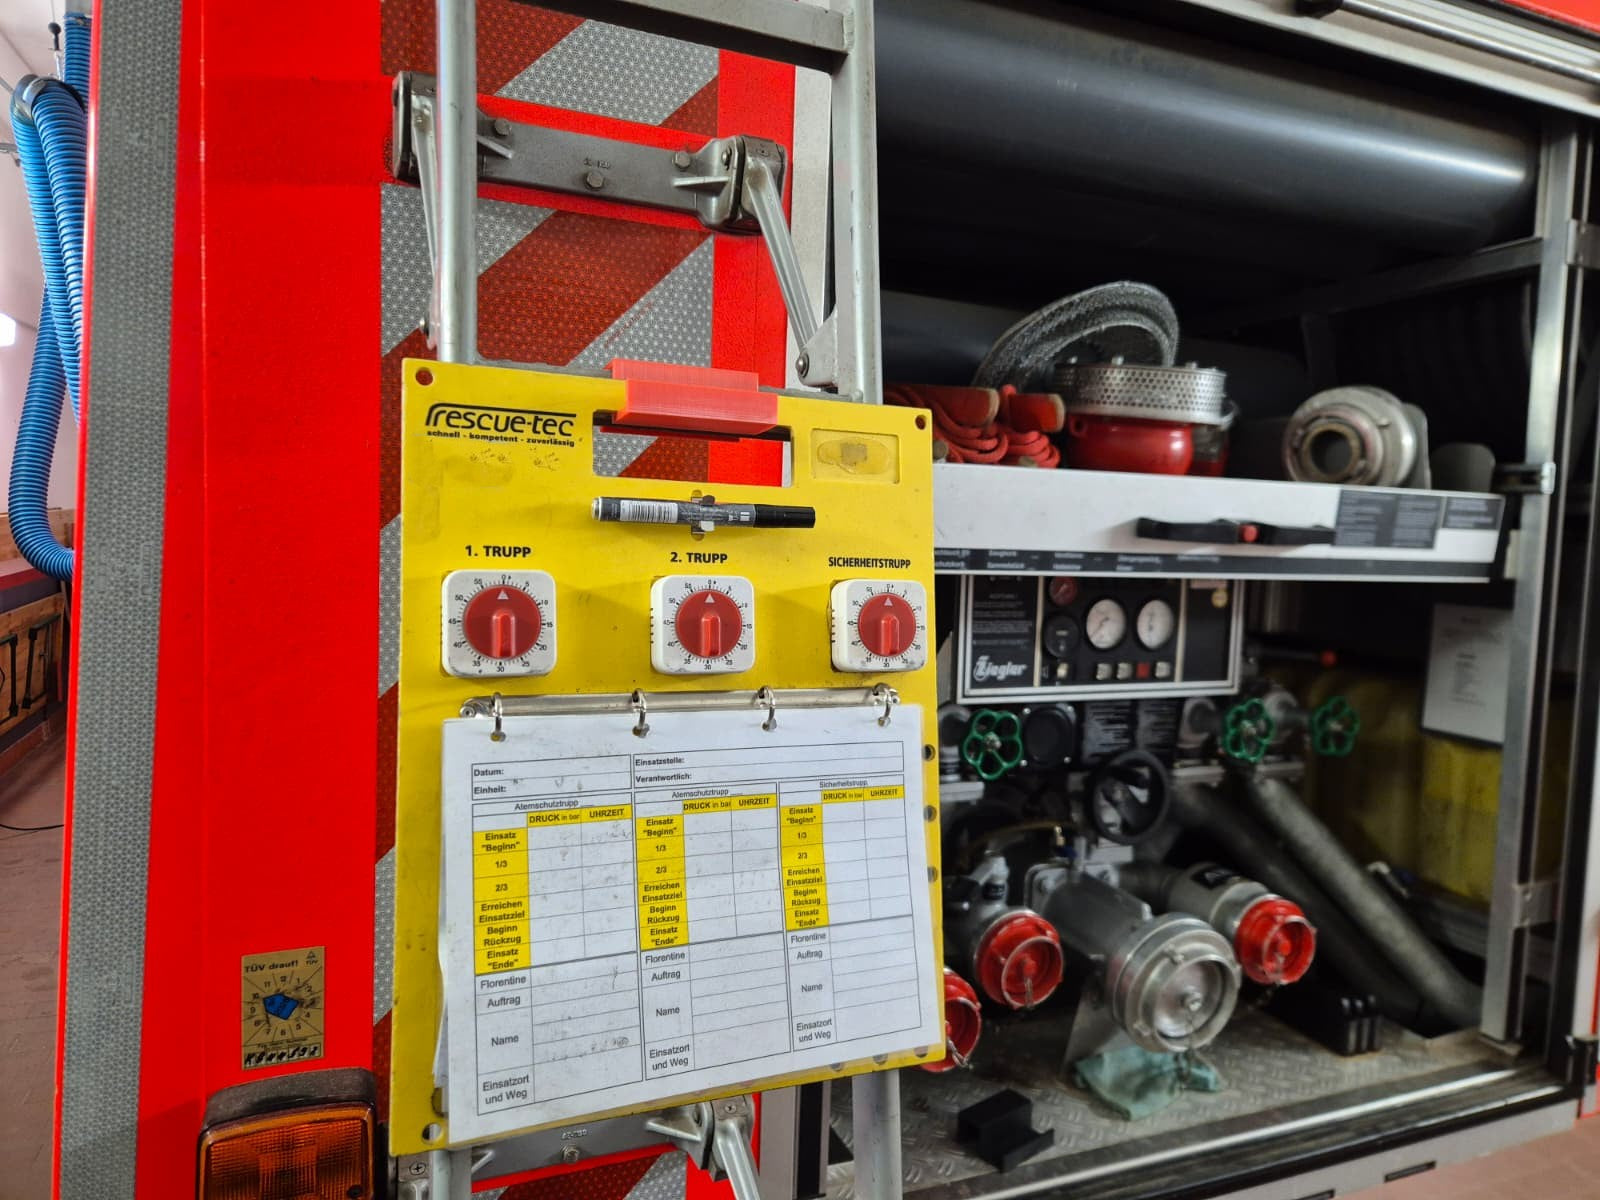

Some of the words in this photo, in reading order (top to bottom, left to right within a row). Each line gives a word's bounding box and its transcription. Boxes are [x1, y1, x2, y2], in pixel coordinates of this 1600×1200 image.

[425, 403, 576, 436] rescue-tec
[427, 430, 460, 438] schnell
[469, 432, 518, 443] kompetent
[526, 437, 575, 447] zuverlässig
[465, 545, 478, 556] 1.
[483, 546, 531, 557] TRUPP
[670, 552, 682, 562] 2.
[687, 553, 727, 563] TRUPP
[828, 557, 911, 569] SICHERHEITSTRUPP
[635, 757, 684, 766] Einsatzstelle:
[473, 769, 504, 777] Datum:
[636, 773, 691, 783] Verantwortlich:
[474, 786, 506, 795] Einheit:
[823, 792, 847, 800] DRUCK
[683, 802, 710, 811] DRUCK
[738, 797, 770, 806] UHRZEIT
[589, 809, 624, 818] UHRZEIT
[789, 807, 813, 815] Einsatz
[529, 814, 560, 823] DRUCK
[646, 818, 674, 826] Einsatz
[485, 832, 516, 840] Einsatz
[643, 827, 677, 837] "Beginn"
[482, 841, 520, 852] "Beginn"
[656, 866, 667, 874] 2/3
[788, 868, 820, 876] Erreichen
[495, 883, 508, 892] 2/3
[644, 882, 680, 892] Erreichen
[794, 888, 817, 896] Beginn
[642, 892, 683, 903] Einsatzziel
[481, 901, 522, 911] Erreichen
[649, 905, 676, 914] Beginn
[479, 911, 525, 923] Einsatzziel
[794, 909, 819, 917] Einsatz
[647, 914, 680, 925] Rückzug
[487, 925, 518, 935] Beginn
[650, 926, 678, 936] Einsatz
[483, 936, 521, 946] Rückzug
[651, 937, 678, 946] "Ende"
[790, 932, 826, 943] Florentine
[487, 949, 518, 959] Einsatz
[645, 951, 685, 964] Florentine
[797, 949, 822, 960] Auftrag
[245, 963, 265, 973] TÜV
[488, 959, 518, 969] "Ende"
[651, 970, 681, 982] Auftrag
[480, 975, 526, 989] Florentine
[801, 983, 822, 992] Name
[487, 995, 521, 1008] Auftrag
[656, 1006, 680, 1017] Name
[796, 1018, 832, 1031] Einsatzort
[491, 1035, 519, 1047] Name
[798, 1034, 813, 1042] und
[814, 1030, 831, 1040] Weg
[649, 1044, 690, 1059] Einsatzort
[652, 1061, 667, 1071] und
[669, 1057, 689, 1066] Weg
[482, 1075, 529, 1091] Einsatzort
[485, 1093, 503, 1105] und
[505, 1089, 528, 1099] Weg
